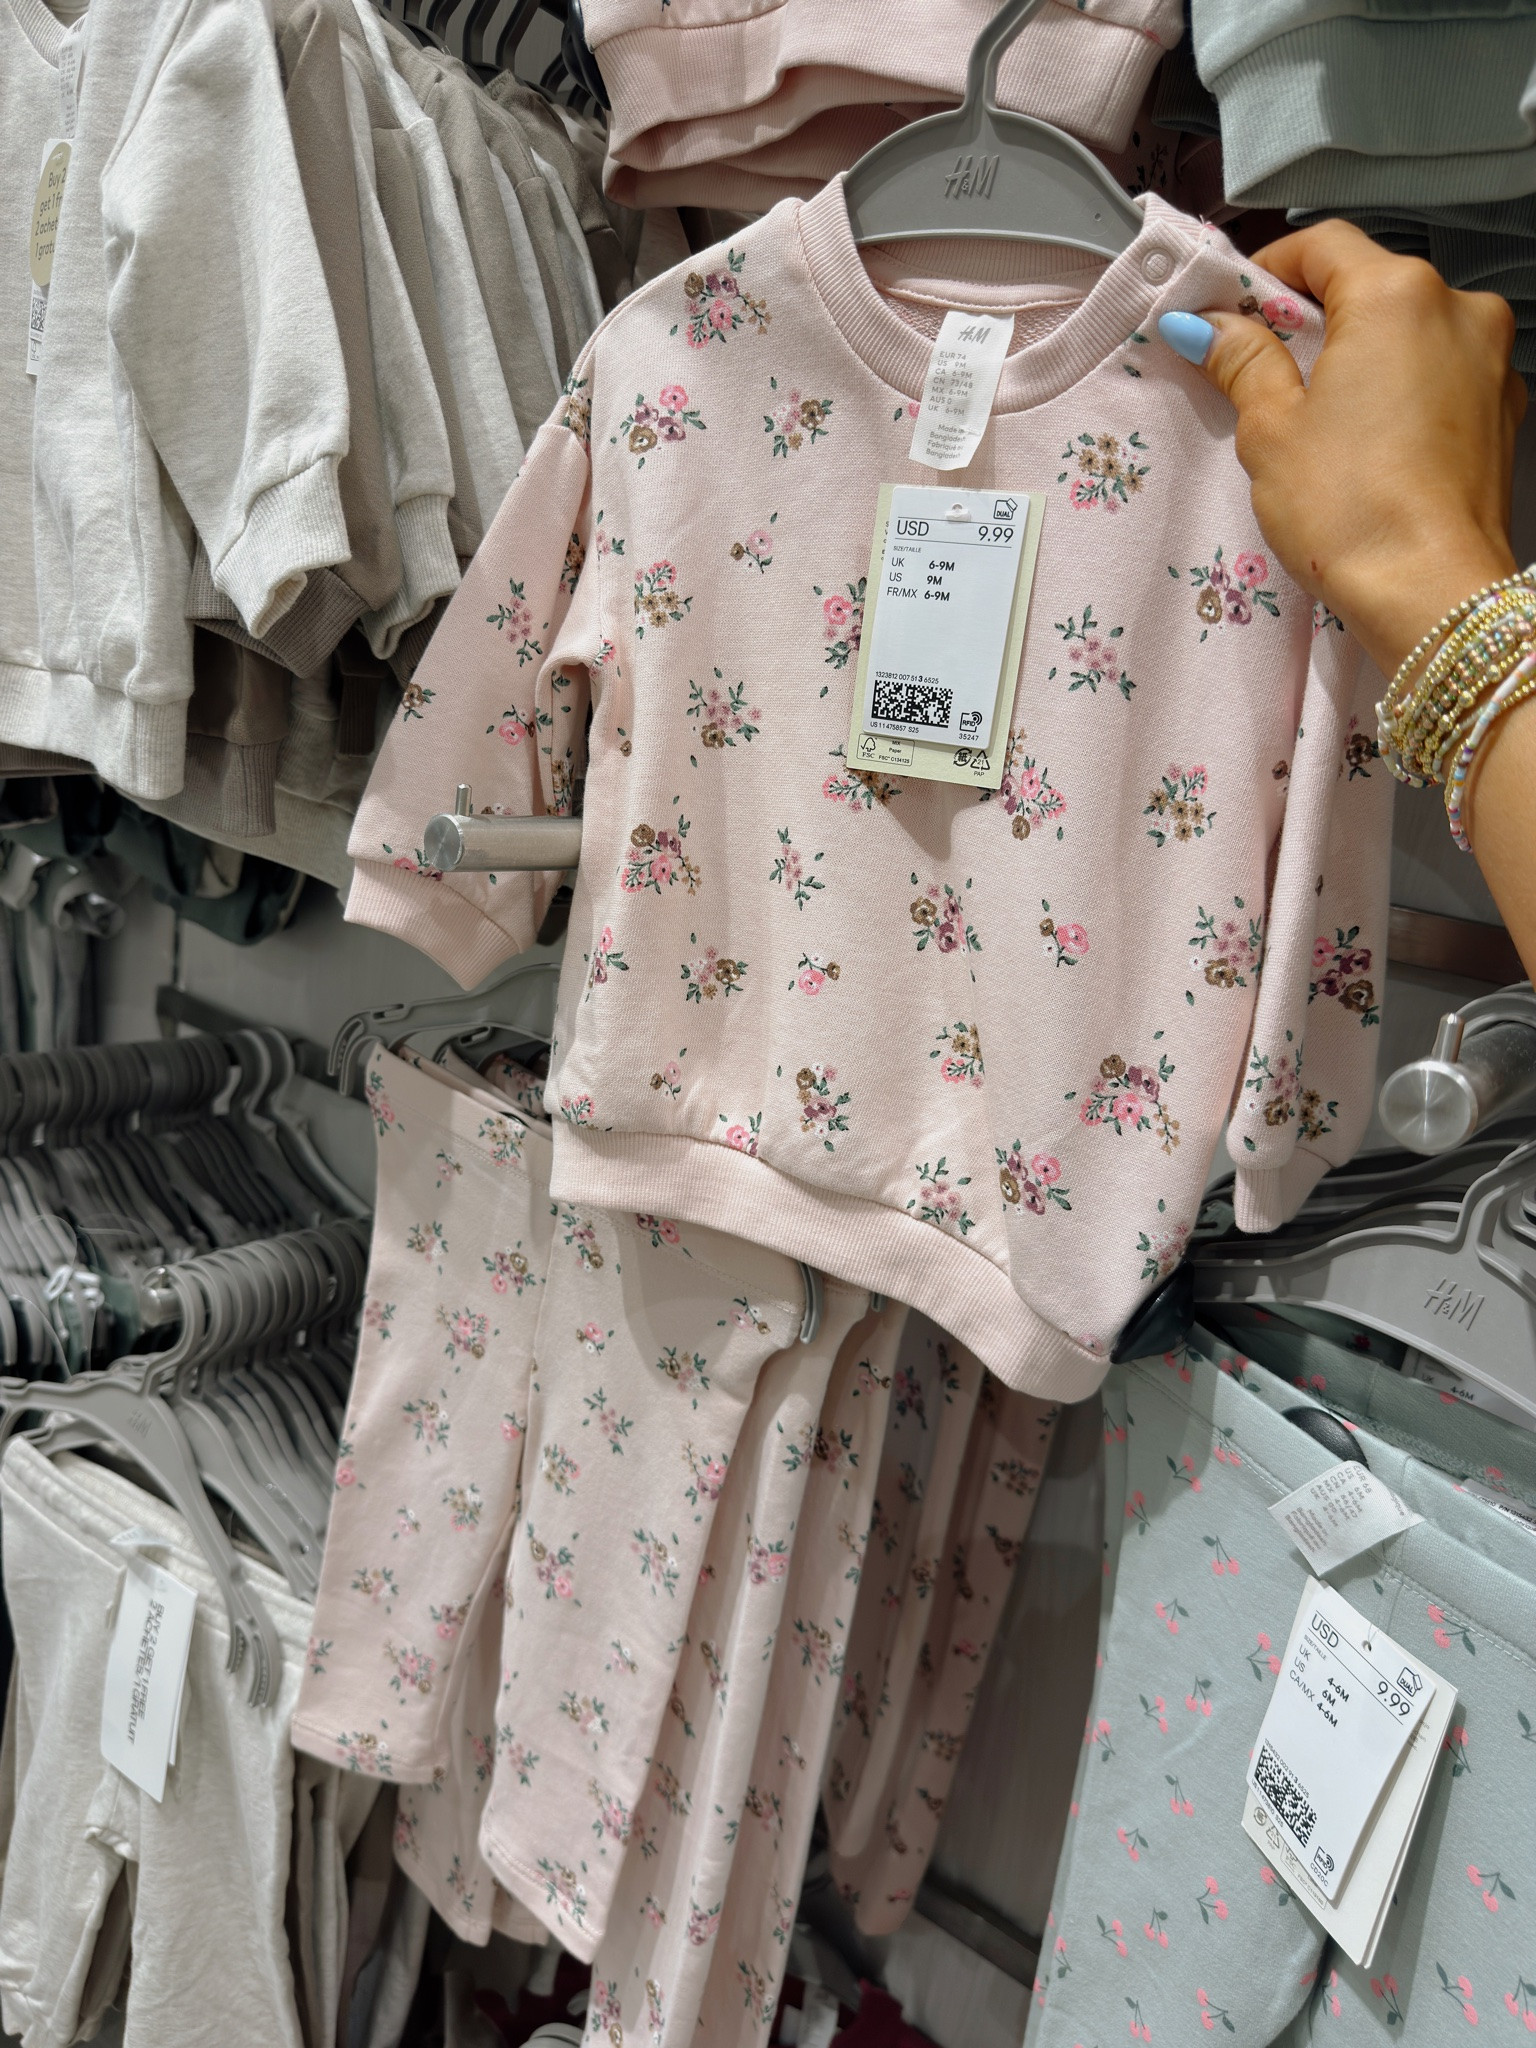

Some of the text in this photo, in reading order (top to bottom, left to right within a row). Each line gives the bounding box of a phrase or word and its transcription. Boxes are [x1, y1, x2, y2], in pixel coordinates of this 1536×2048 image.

[48, 168, 66, 189] Buy 2
[944, 154, 1000, 200] H&M
[40, 196, 51, 216] get
[35, 216, 58, 236] 2 achet
[958, 325, 991, 344] H&M
[940, 351, 955, 359] EUR
[952, 370, 973, 379] 6-9M
[938, 424, 957, 433] Made
[896, 520, 1014, 543] USD 9.99
[893, 545, 921, 554] SIZE/TAILLE
[891, 557, 955, 571] UK 6-9M
[889, 572, 942, 585] US 9M
[887, 587, 950, 601] FR/MX 6-9M
[876, 671, 898, 679] 1323812
[1424, 1278, 1485, 1332] H&M
[1330, 1475, 1340, 1489] CN
[1337, 1472, 1346, 1485] CA
[150, 1599, 158, 1610] 2
[153, 1603, 164, 1635] BUY
[150, 1633, 157, 1646] 2
[1303, 1634, 1327, 1661] SIZE/TAILLE
[1299, 1644, 1350, 1702] UK 4-6M
[1311, 1614, 1410, 1717] USD 9.99
[1294, 1657, 1336, 1707] US 6M
[1400, 1678, 1414, 1693] DUAL
[1289, 1670, 1338, 1727] CA/MX 4-6M
[1317, 1854, 1328, 1868] RFID
